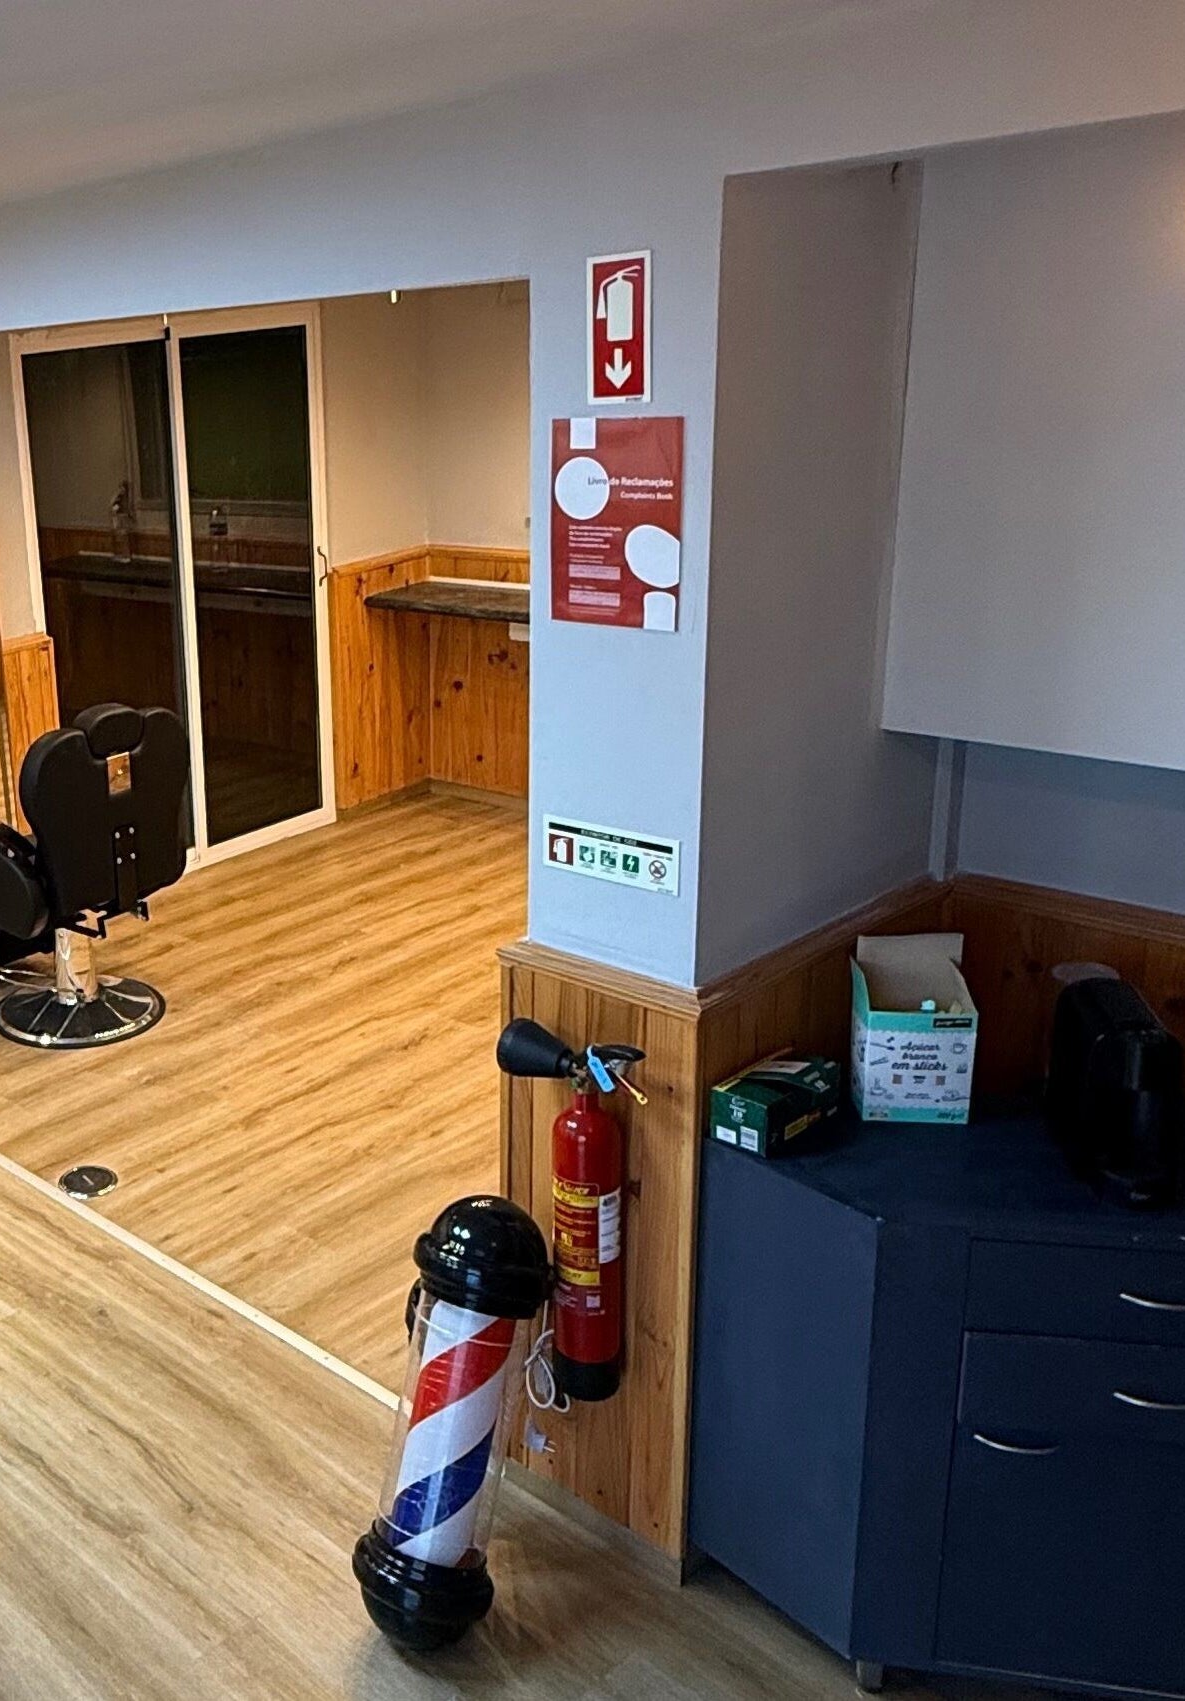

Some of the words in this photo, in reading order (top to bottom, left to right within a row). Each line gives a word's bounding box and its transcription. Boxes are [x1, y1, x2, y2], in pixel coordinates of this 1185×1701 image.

[587, 477, 607, 486] Livro
[609, 477, 620, 486] de
[621, 477, 674, 488] Reclamações
[891, 1062, 909, 1070] em
[912, 1060, 948, 1071] sticks
